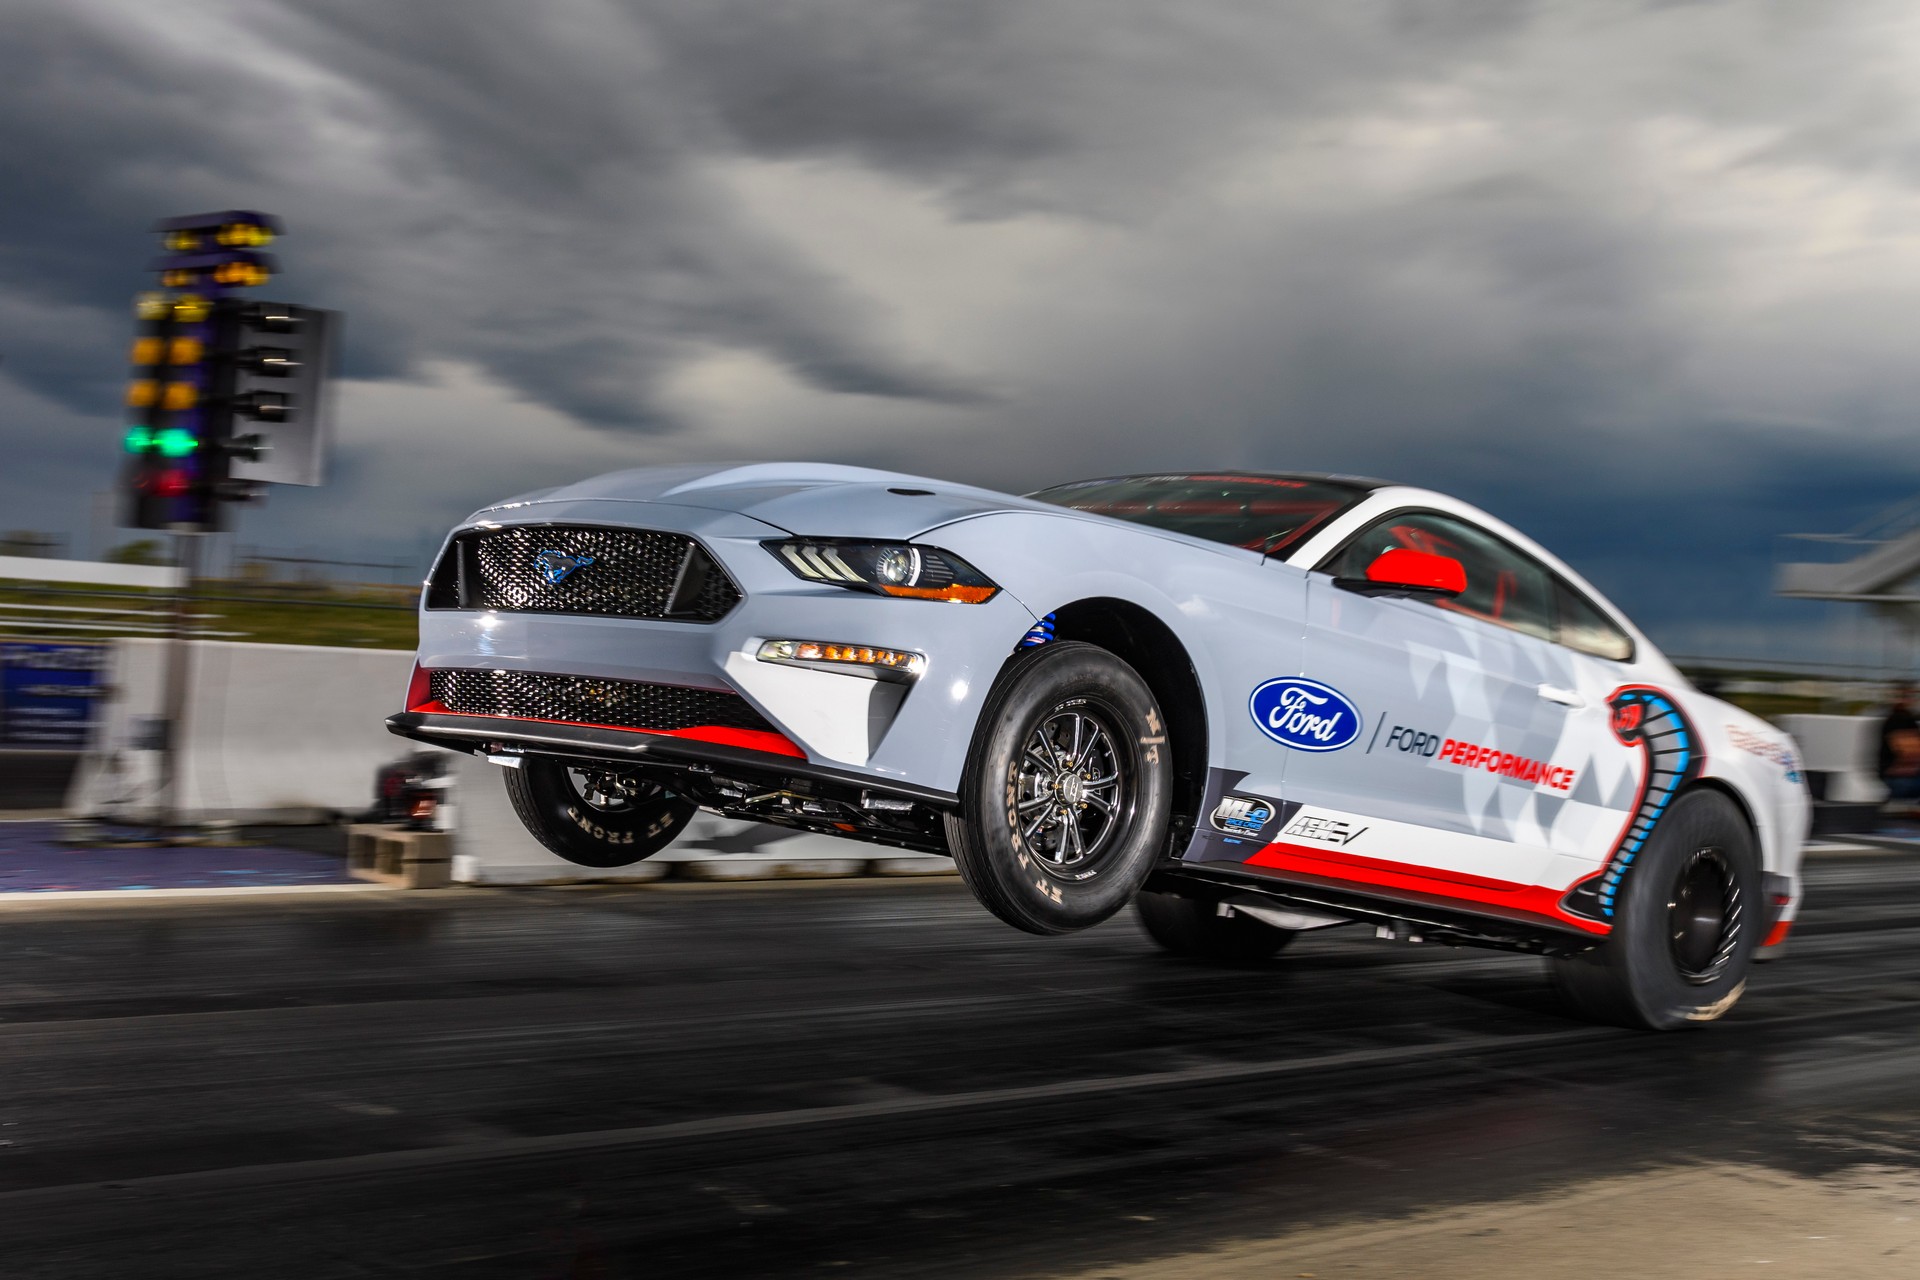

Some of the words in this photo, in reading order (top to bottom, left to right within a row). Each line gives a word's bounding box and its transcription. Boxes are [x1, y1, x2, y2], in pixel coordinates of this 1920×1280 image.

[1269, 687, 1343, 741] Ford
[1386, 726, 1440, 758] FORD
[1437, 738, 1576, 791] PERFORMANCE
